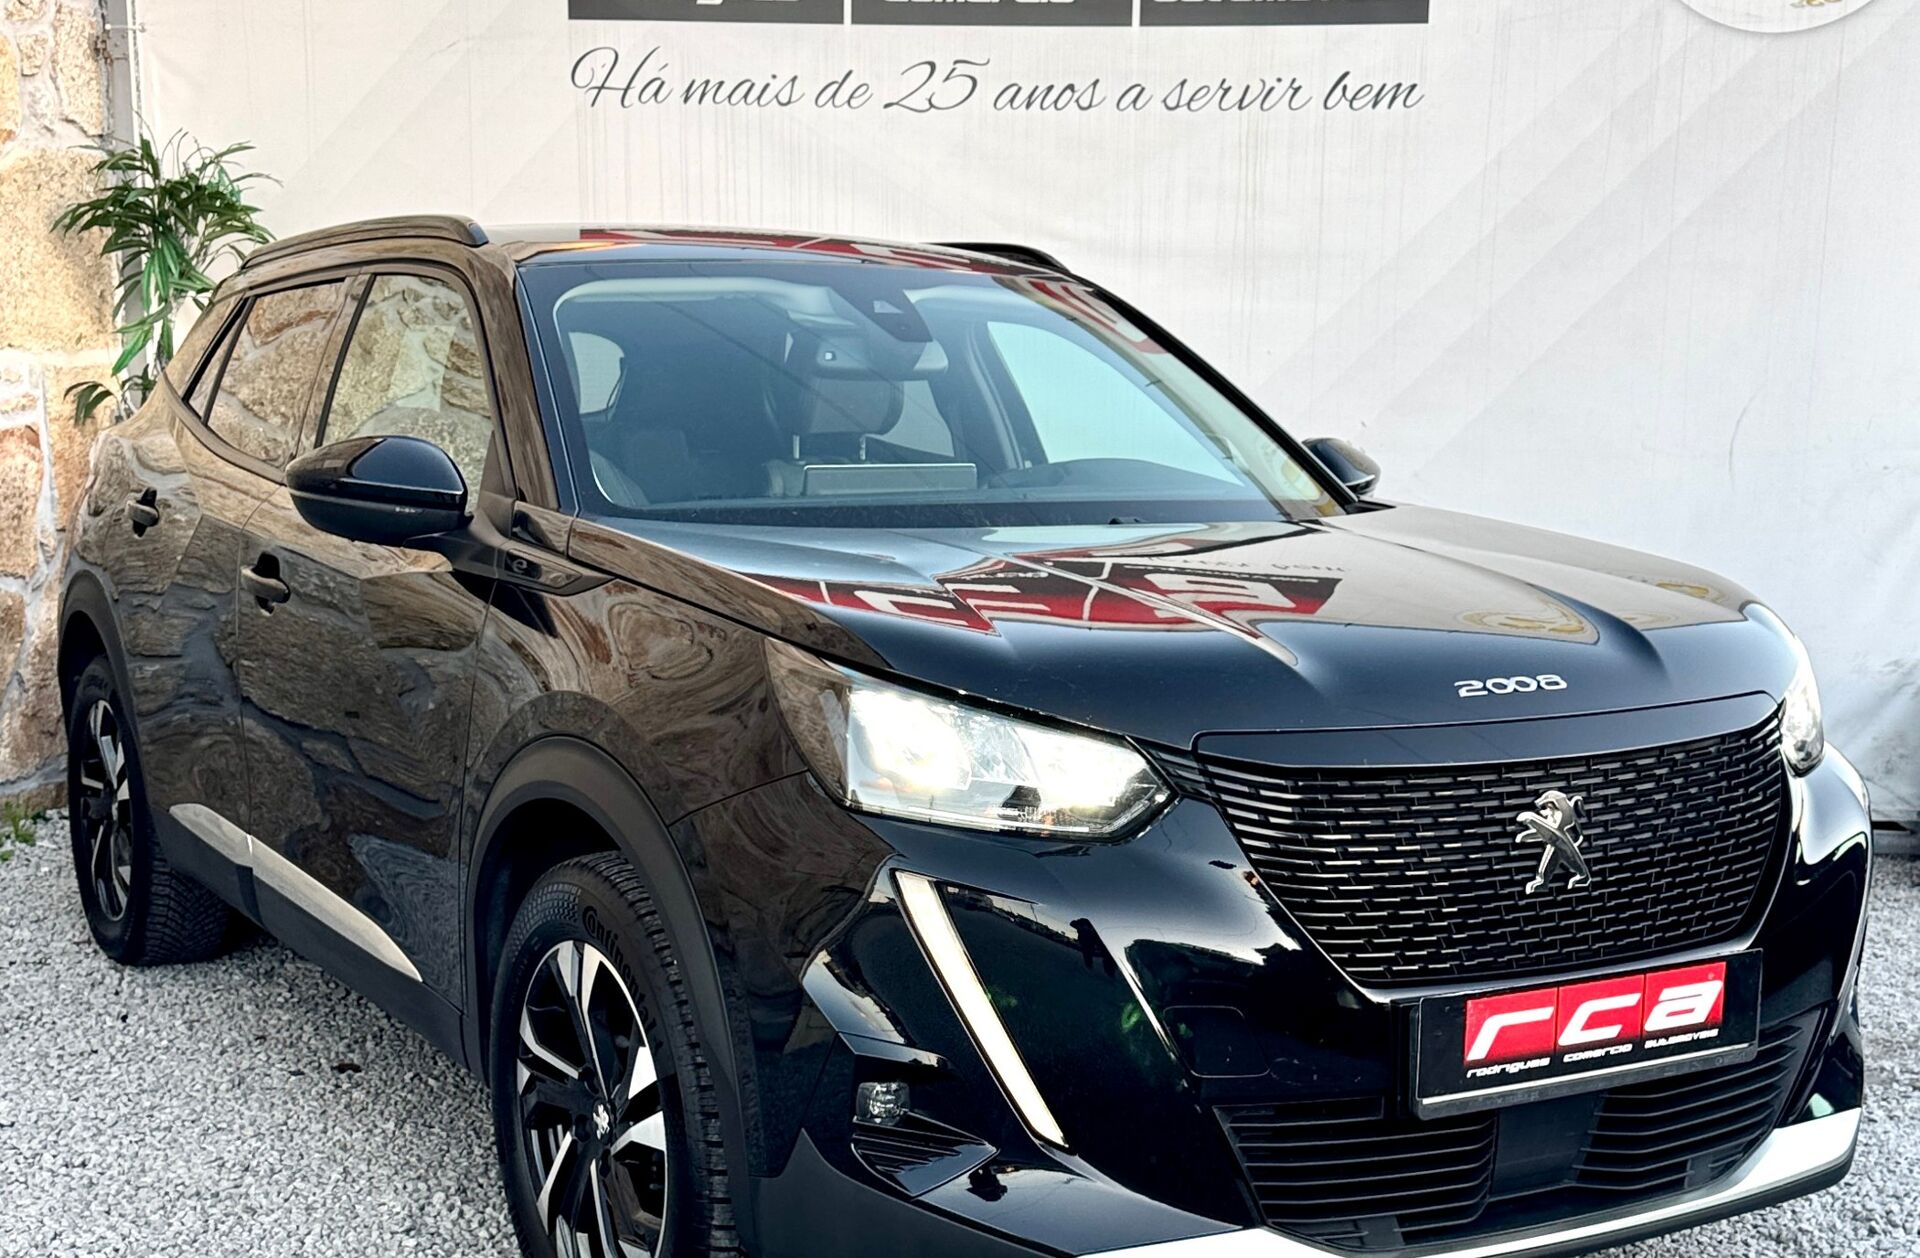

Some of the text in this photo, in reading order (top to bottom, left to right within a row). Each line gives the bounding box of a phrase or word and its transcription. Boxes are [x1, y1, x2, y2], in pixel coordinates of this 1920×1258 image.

[570, 46, 1425, 113] Há mais de 25 anos a servir bem
[1454, 674, 1568, 698] 2008
[582, 905, 657, 1032] Continental
[1466, 1057, 1551, 1079] rodrigues
